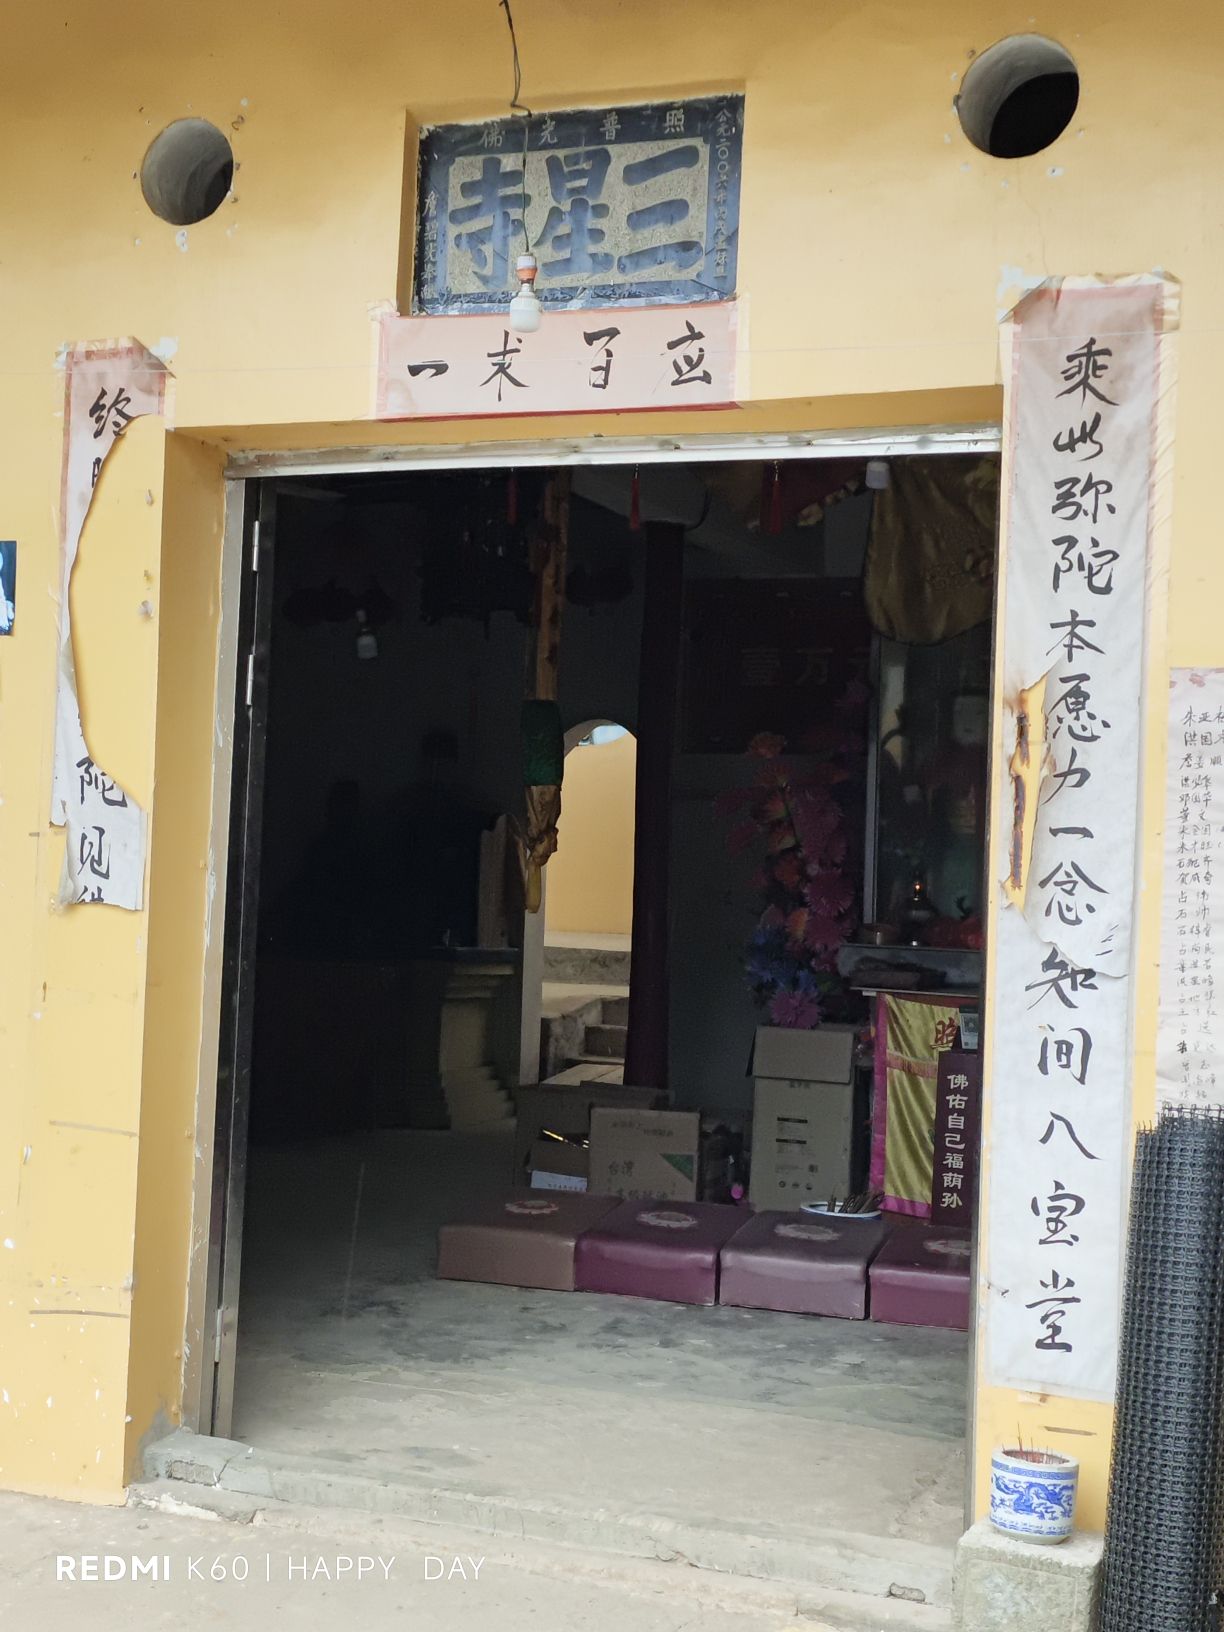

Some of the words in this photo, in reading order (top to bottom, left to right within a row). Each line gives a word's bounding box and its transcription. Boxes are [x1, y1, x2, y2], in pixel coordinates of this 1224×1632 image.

[480, 107, 685, 149] 佛光普照
[406, 319, 713, 402] 一求百应
